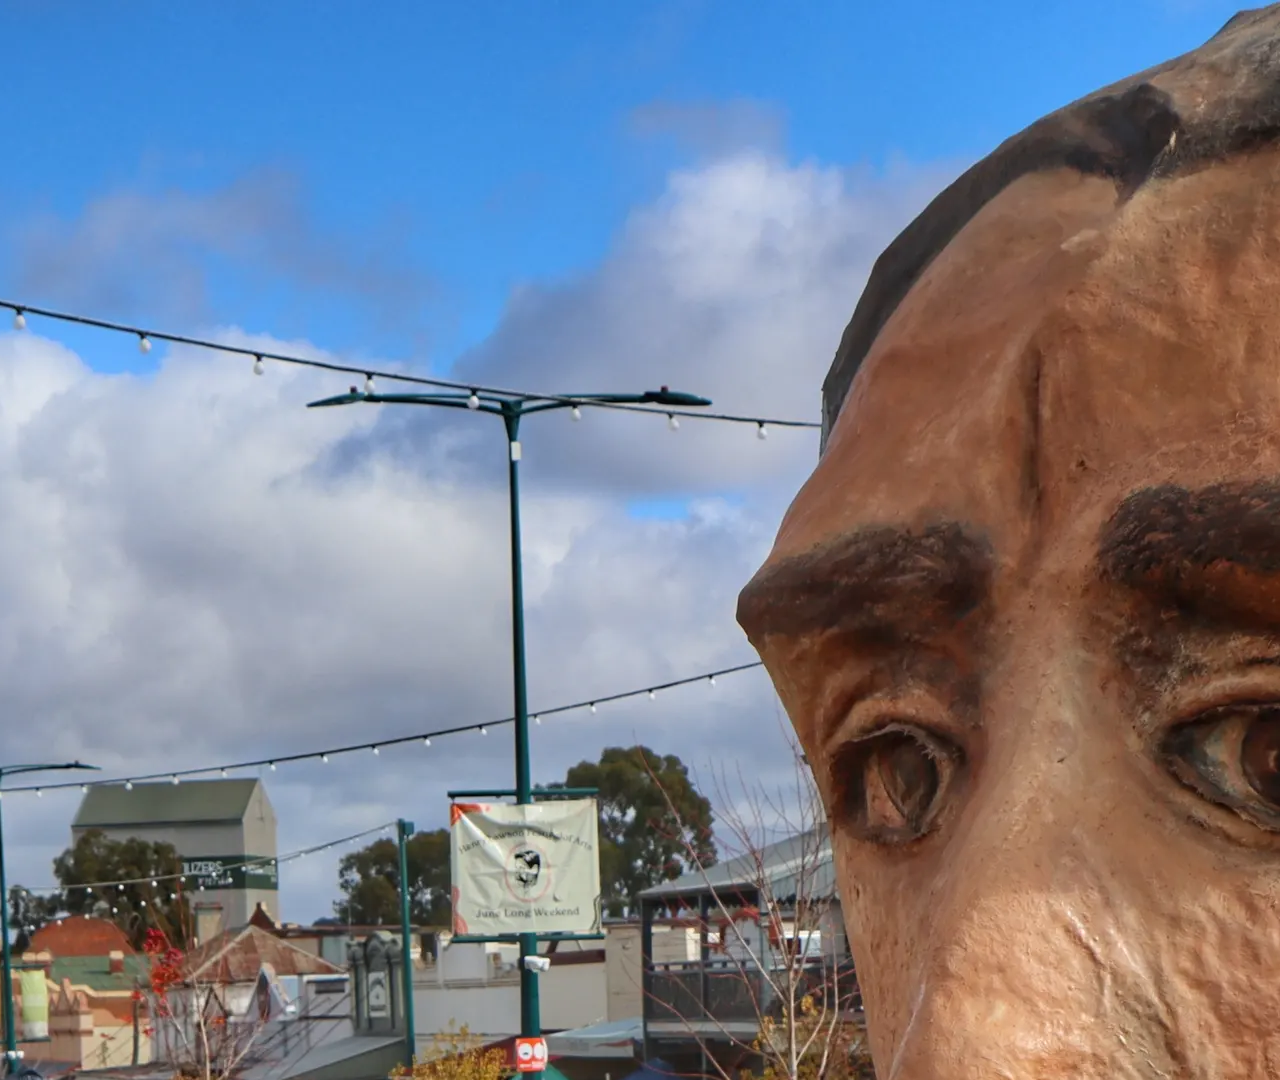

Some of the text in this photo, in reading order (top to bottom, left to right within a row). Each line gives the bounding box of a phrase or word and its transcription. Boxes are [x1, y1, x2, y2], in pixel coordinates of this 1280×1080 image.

[527, 829, 563, 841] Festil
[573, 836, 593, 851] Arts
[476, 906, 580, 918] June Long Weekend
